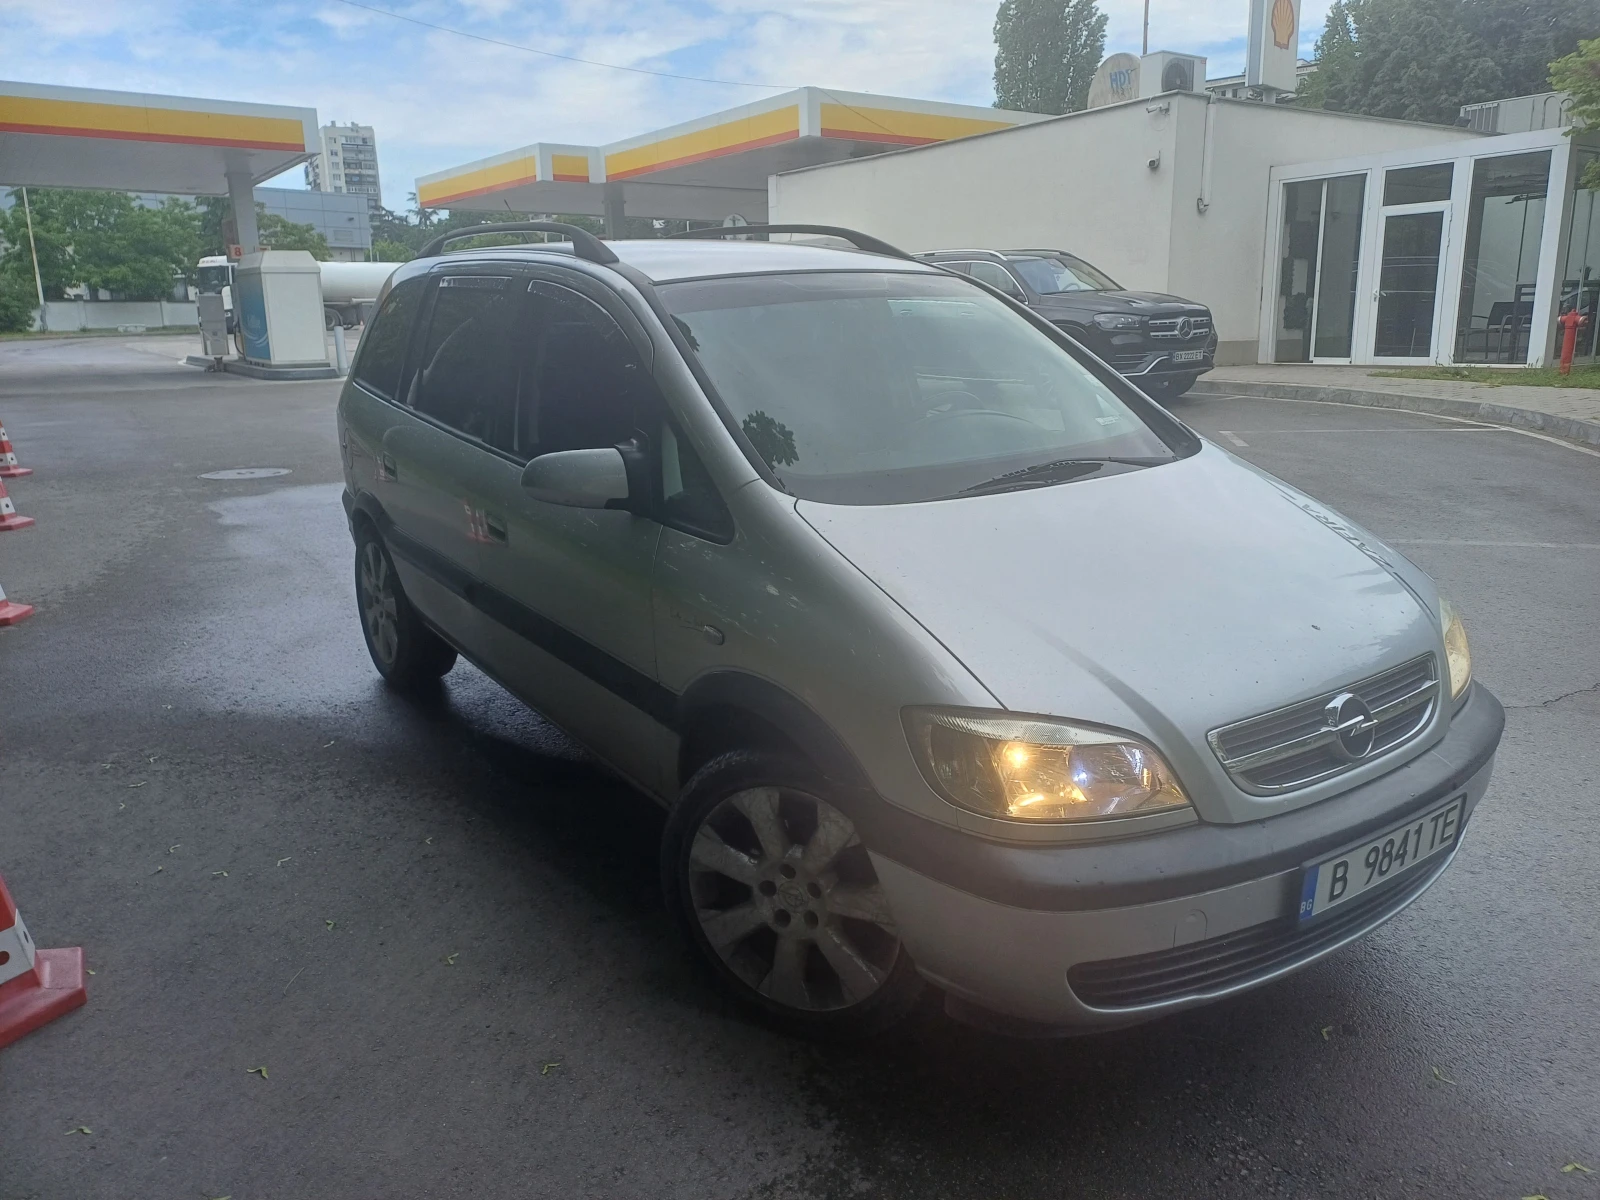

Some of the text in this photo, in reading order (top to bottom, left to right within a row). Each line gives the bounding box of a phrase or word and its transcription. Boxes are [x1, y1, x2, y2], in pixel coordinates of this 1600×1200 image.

[234, 246, 242, 257] 8
[1301, 503, 1394, 569] ZAFIRA
[1328, 804, 1459, 903] B 9841 TE
[1300, 899, 1313, 914] BG
